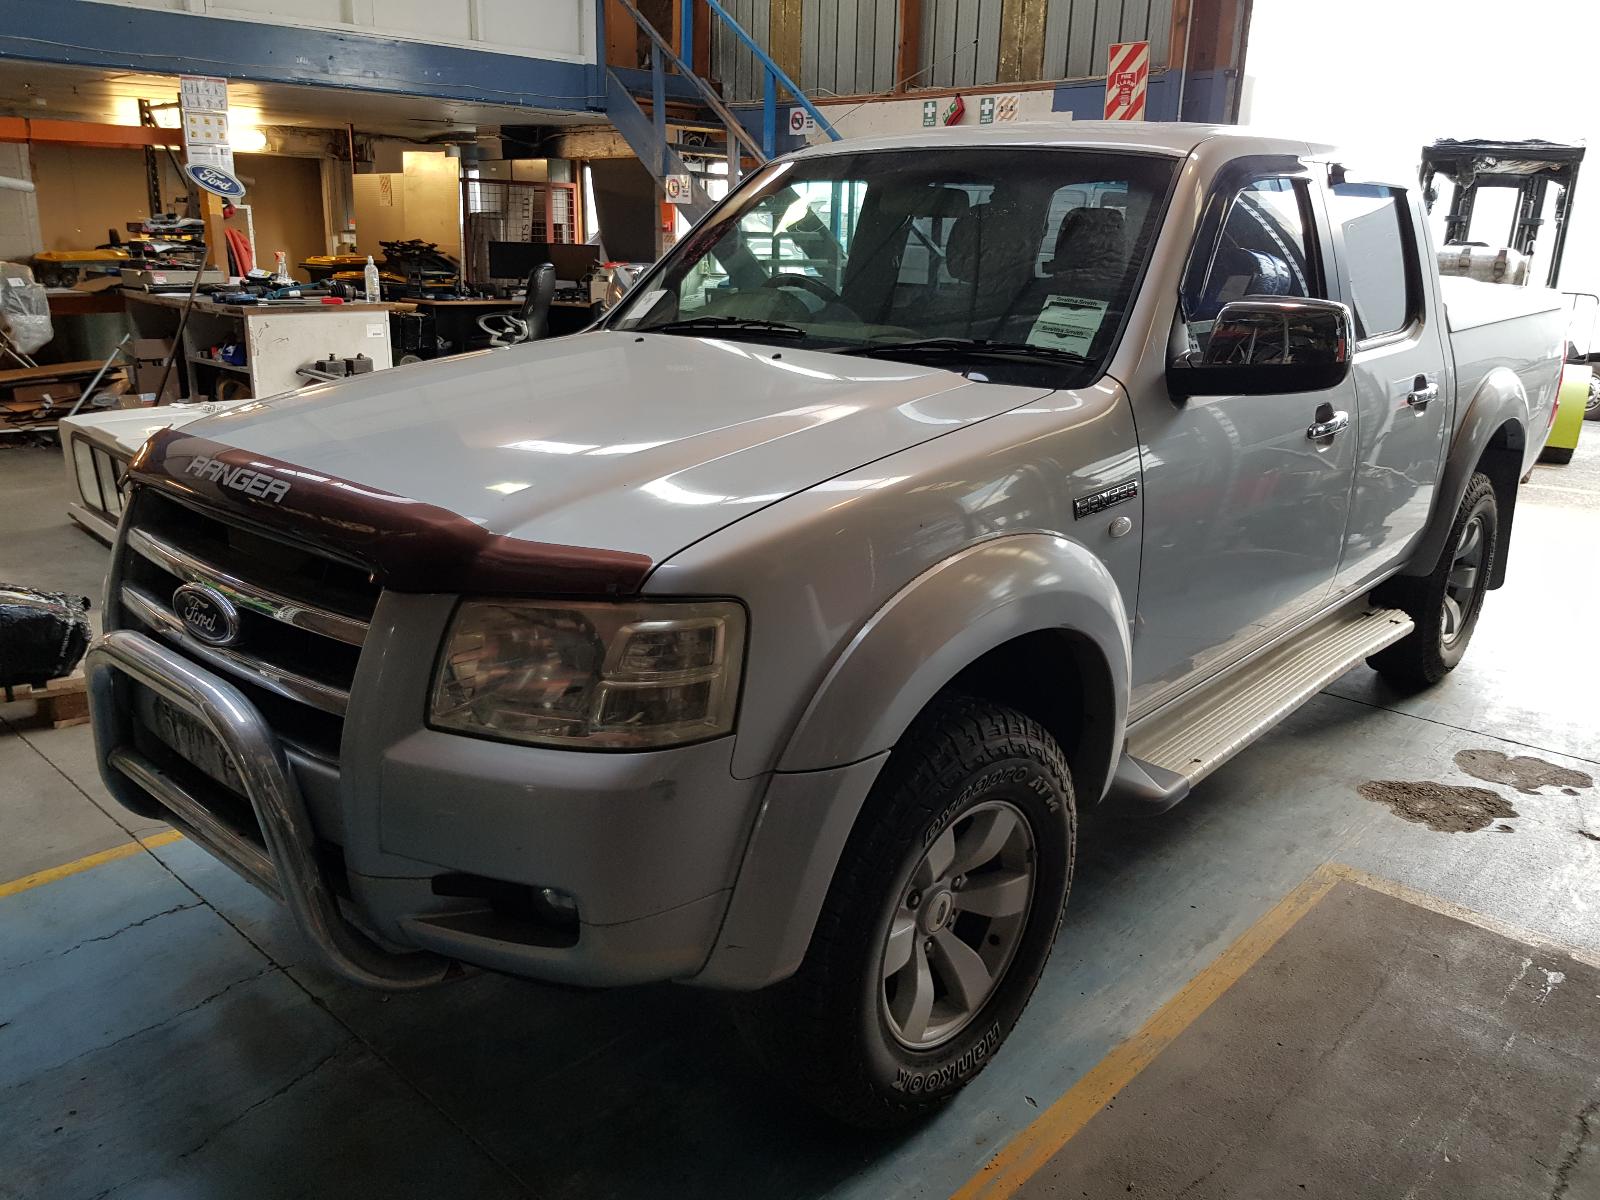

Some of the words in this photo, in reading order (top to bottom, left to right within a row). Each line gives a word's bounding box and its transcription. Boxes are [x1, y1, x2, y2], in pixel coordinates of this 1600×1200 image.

[199, 168, 233, 191] Ford
[185, 455, 292, 503] RANGER
[184, 595, 217, 632] Ford
[891, 1019, 1001, 1094] Hankook
